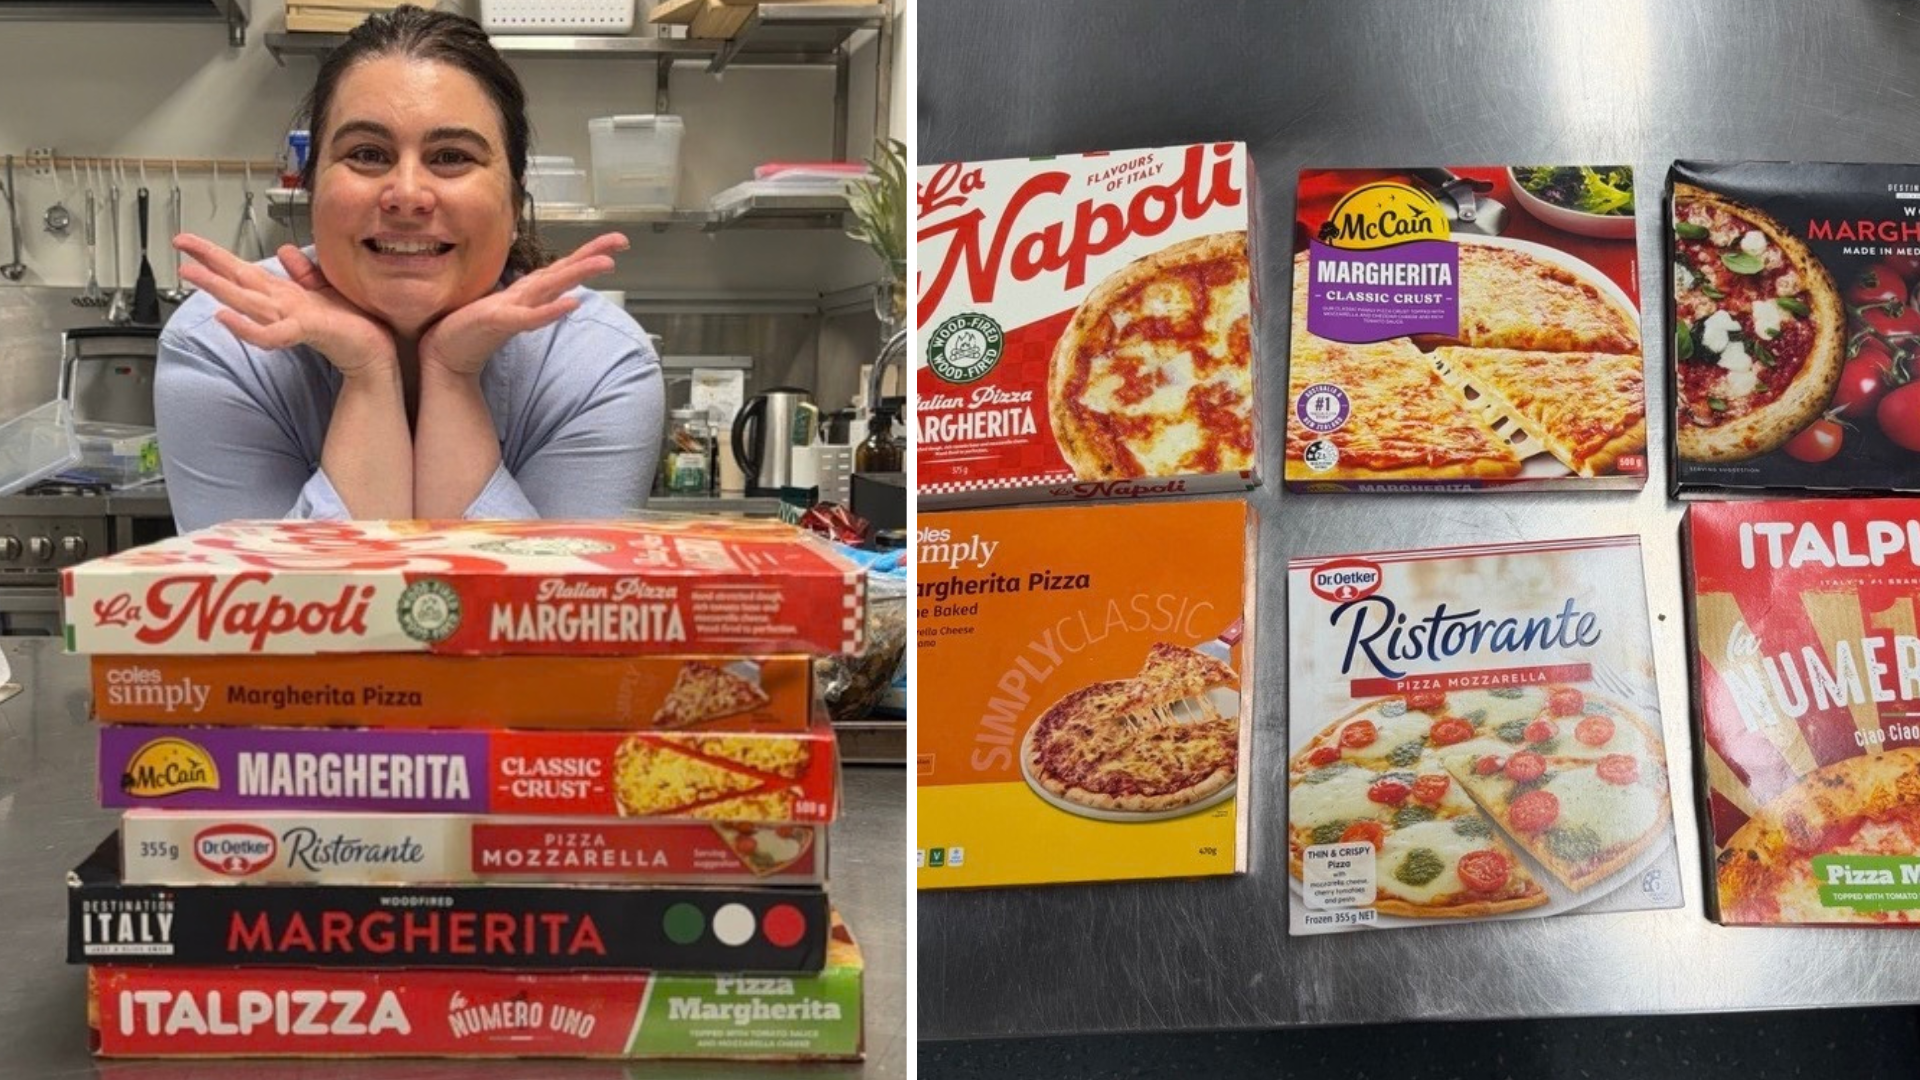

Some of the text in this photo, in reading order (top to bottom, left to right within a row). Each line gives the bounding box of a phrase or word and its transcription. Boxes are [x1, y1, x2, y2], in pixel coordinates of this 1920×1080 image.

[1086, 153, 1154, 187] FLAVOURS
[1106, 163, 1164, 192] OF ITALY
[1887, 183, 1920, 192] DESTIN
[1339, 209, 1434, 241] McCain
[1808, 219, 1920, 242] MARGH
[917, 143, 1242, 331] Napoli
[1843, 246, 1920, 256] MADE IN MED
[1317, 260, 1453, 286] MARGHERITA
[1325, 290, 1443, 304] CLASSIC CRUST
[932, 317, 999, 348] WOOD-FIRED
[932, 349, 997, 380] WOOD-FIRED
[917, 384, 1033, 411] talian Pizza
[1315, 396, 1330, 411] #1
[917, 405, 1038, 444] ARGHERITA
[1072, 480, 1186, 498] Napoli
[917, 526, 952, 544] oles
[1738, 519, 1920, 570] ITALPI
[917, 533, 1000, 570] mply
[536, 576, 679, 603] Italian Pizza
[917, 569, 1091, 601] argherita Pizza
[1887, 578, 1920, 586] BRAN
[93, 571, 377, 653] La Napoli
[933, 602, 979, 618] Baked
[489, 601, 687, 643] MARGHERITA
[939, 625, 975, 636] Cheese
[917, 640, 937, 648] ano
[1330, 594, 1602, 678] Ristorante
[107, 665, 162, 684] coles
[1397, 672, 1547, 691] PIZZA MOZZARELLA
[1722, 634, 1920, 734] NUMER
[107, 677, 211, 712] simply
[227, 685, 423, 710] Margherita Pizza
[1854, 722, 1920, 747] Ciao Ciao
[136, 763, 207, 790] McCain
[238, 751, 471, 800] MARGHERITA
[501, 757, 602, 776] CLASSIC
[511, 779, 591, 799] CRUST
[282, 827, 425, 872] Ristorante
[544, 832, 606, 847] PIZZA
[482, 849, 669, 867] MOZZARELLA
[693, 849, 727, 859] Serving
[1308, 846, 1371, 859] THIN & CRISPY
[692, 860, 741, 869] suggestion
[1327, 860, 1352, 869] Pizza
[1825, 863, 1920, 886] Pizza M
[1310, 880, 1345, 888] mozzarella
[1336, 887, 1366, 895] tomatoes
[83, 900, 175, 913] DESTINATION
[380, 896, 455, 907] WOODFIRED
[1833, 892, 1918, 900] TOPPED WITH TOMATO
[83, 912, 174, 943] ITALY
[1305, 914, 1333, 925] Frozen
[1358, 910, 1375, 921] NET
[227, 910, 607, 956] MARGHERITA
[715, 972, 795, 995] Pizza
[119, 989, 412, 1037] ITALPIZZA
[448, 1000, 597, 1039] NUMERO UNO
[668, 996, 842, 1026] Margherita
[689, 1029, 819, 1038] TOPPED WITH TOMATO SAUCE
[697, 1039, 717, 1048] AND
[718, 1040, 775, 1048] MOZZARELLA
